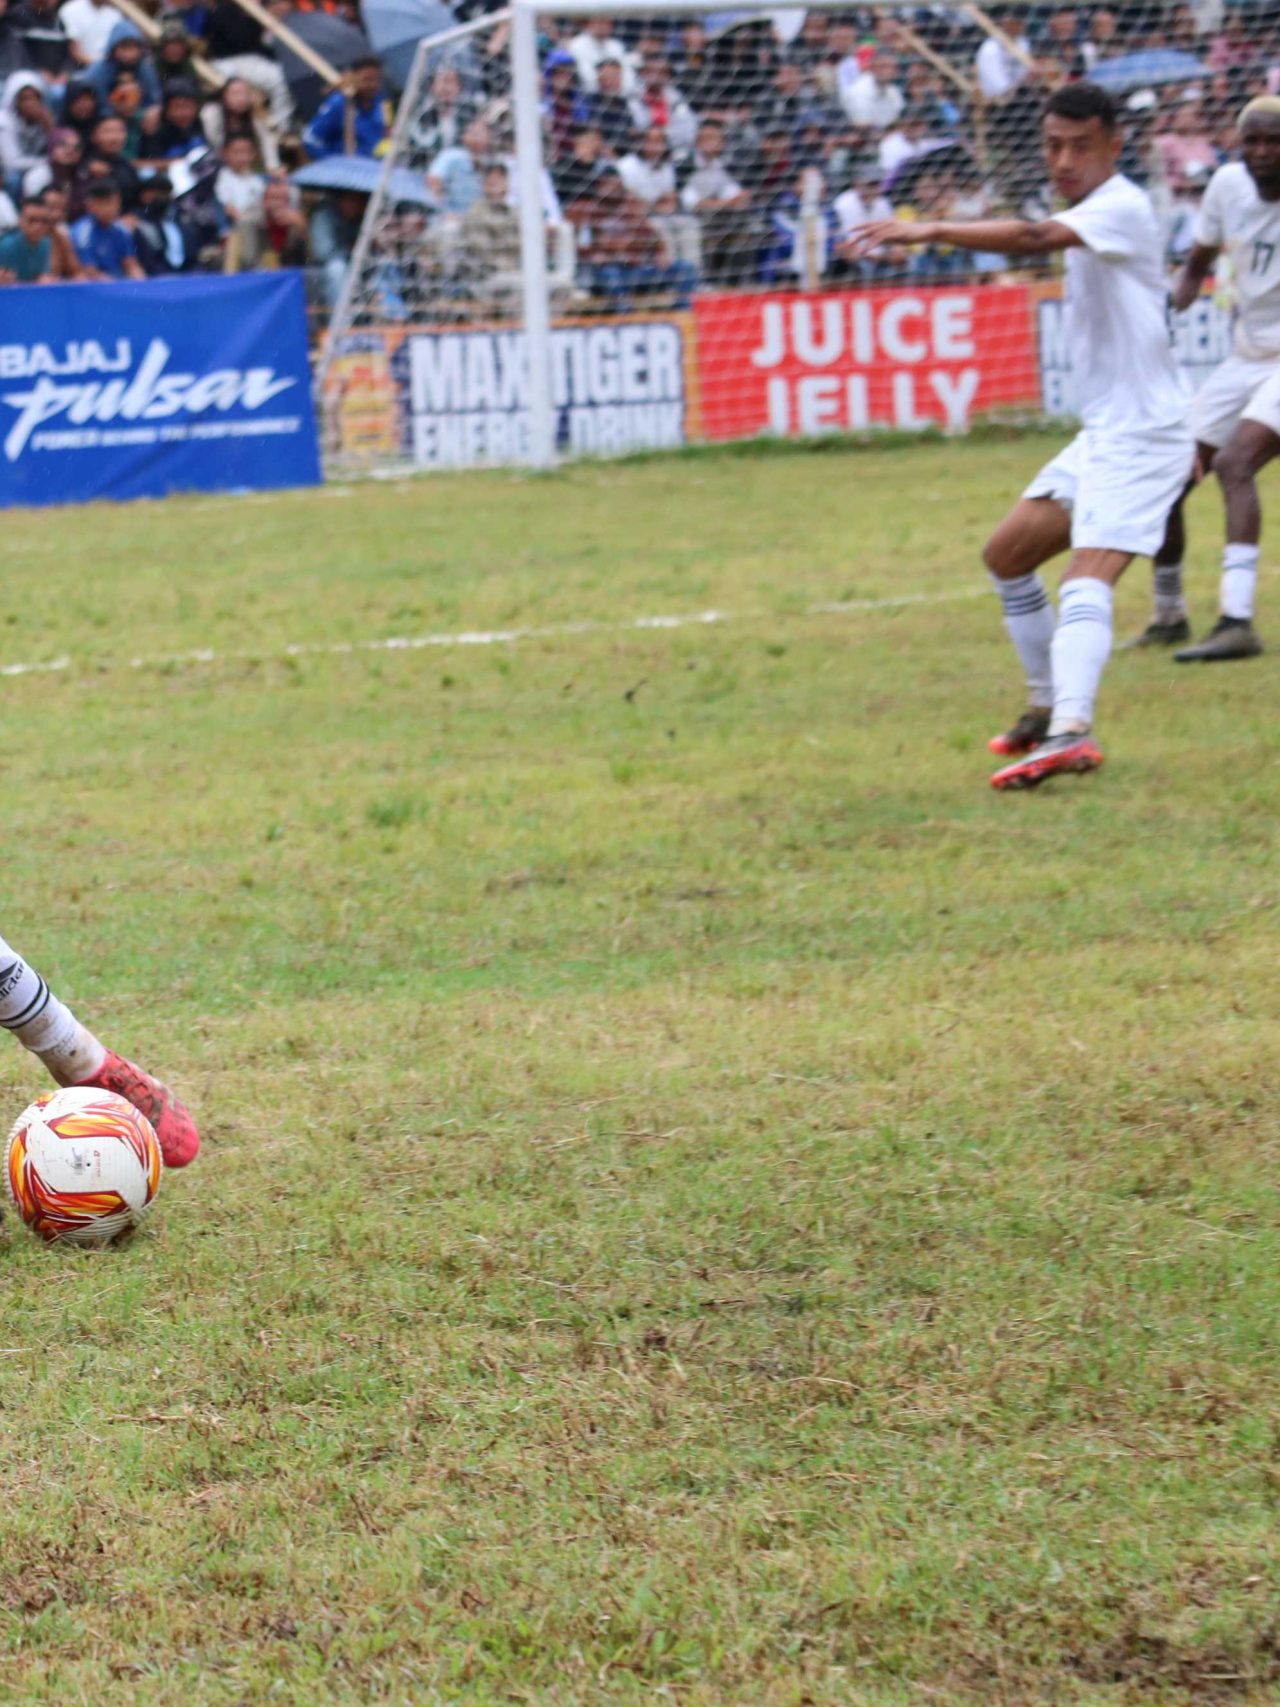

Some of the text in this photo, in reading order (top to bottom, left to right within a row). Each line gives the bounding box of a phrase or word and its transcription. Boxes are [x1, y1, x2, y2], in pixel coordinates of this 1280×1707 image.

[751, 297, 976, 367] JUICE
[409, 324, 682, 411] MAX TIGER
[762, 366, 981, 437] JELLY
[414, 411, 562, 467] ENERG
